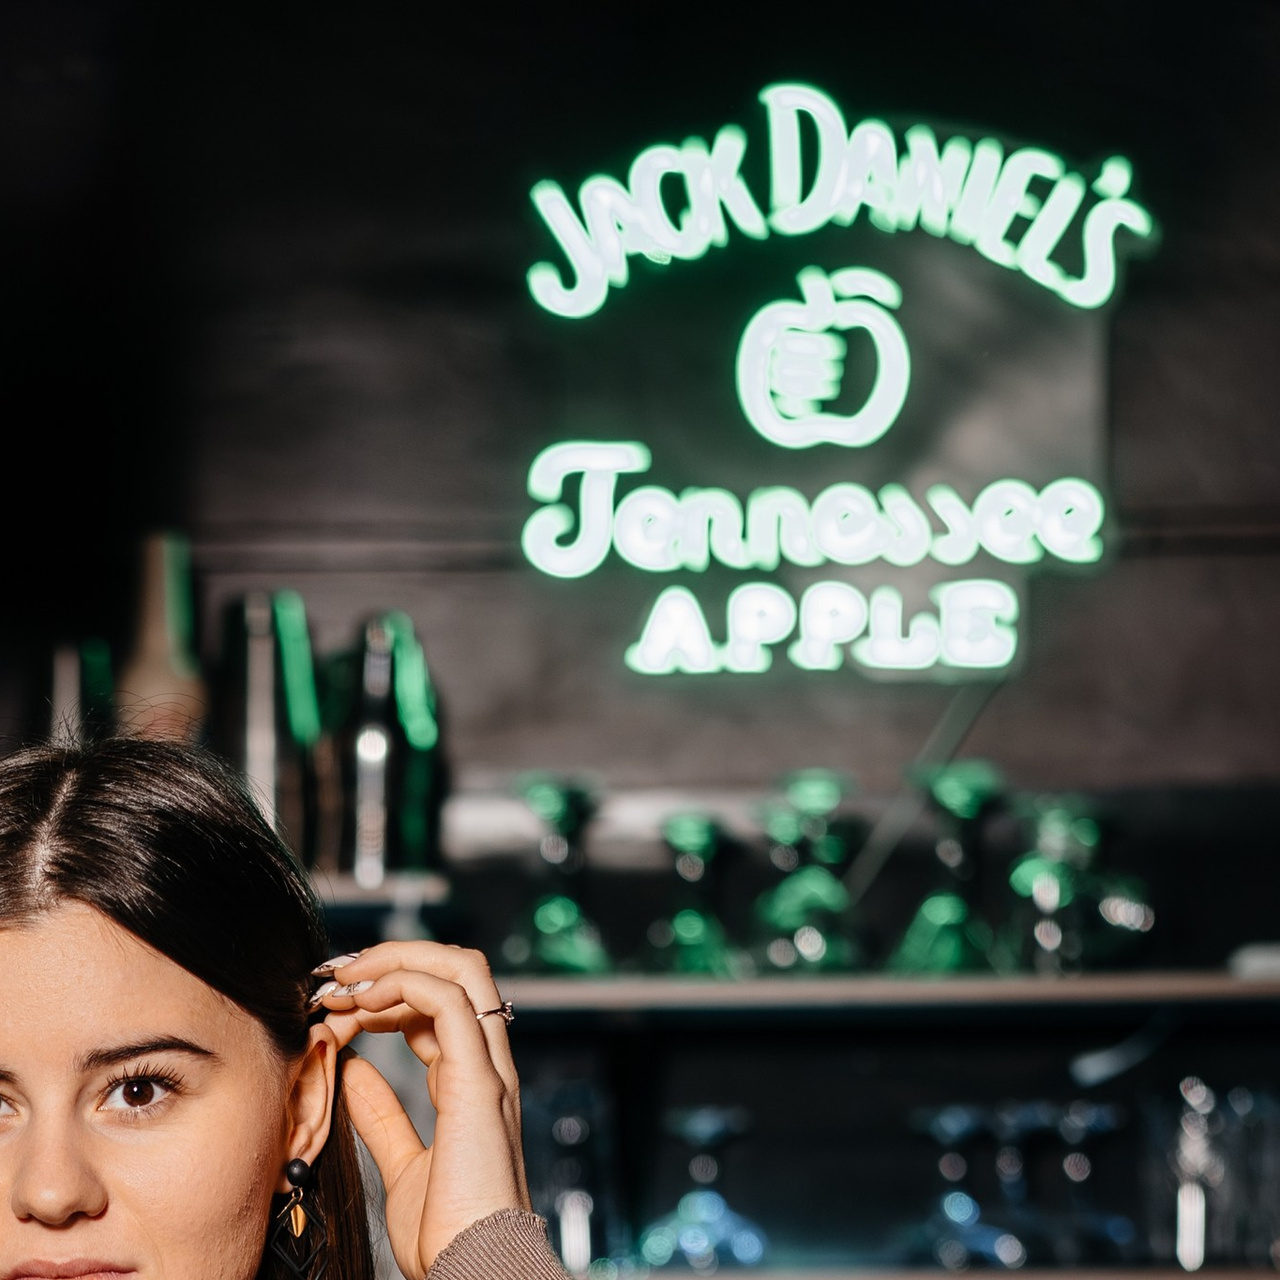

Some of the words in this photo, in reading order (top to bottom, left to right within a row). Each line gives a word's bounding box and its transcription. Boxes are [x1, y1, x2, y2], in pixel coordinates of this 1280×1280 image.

[526, 122, 769, 318] JACK
[522, 440, 1106, 578] Tennessee
[625, 578, 1020, 675] APPLE
